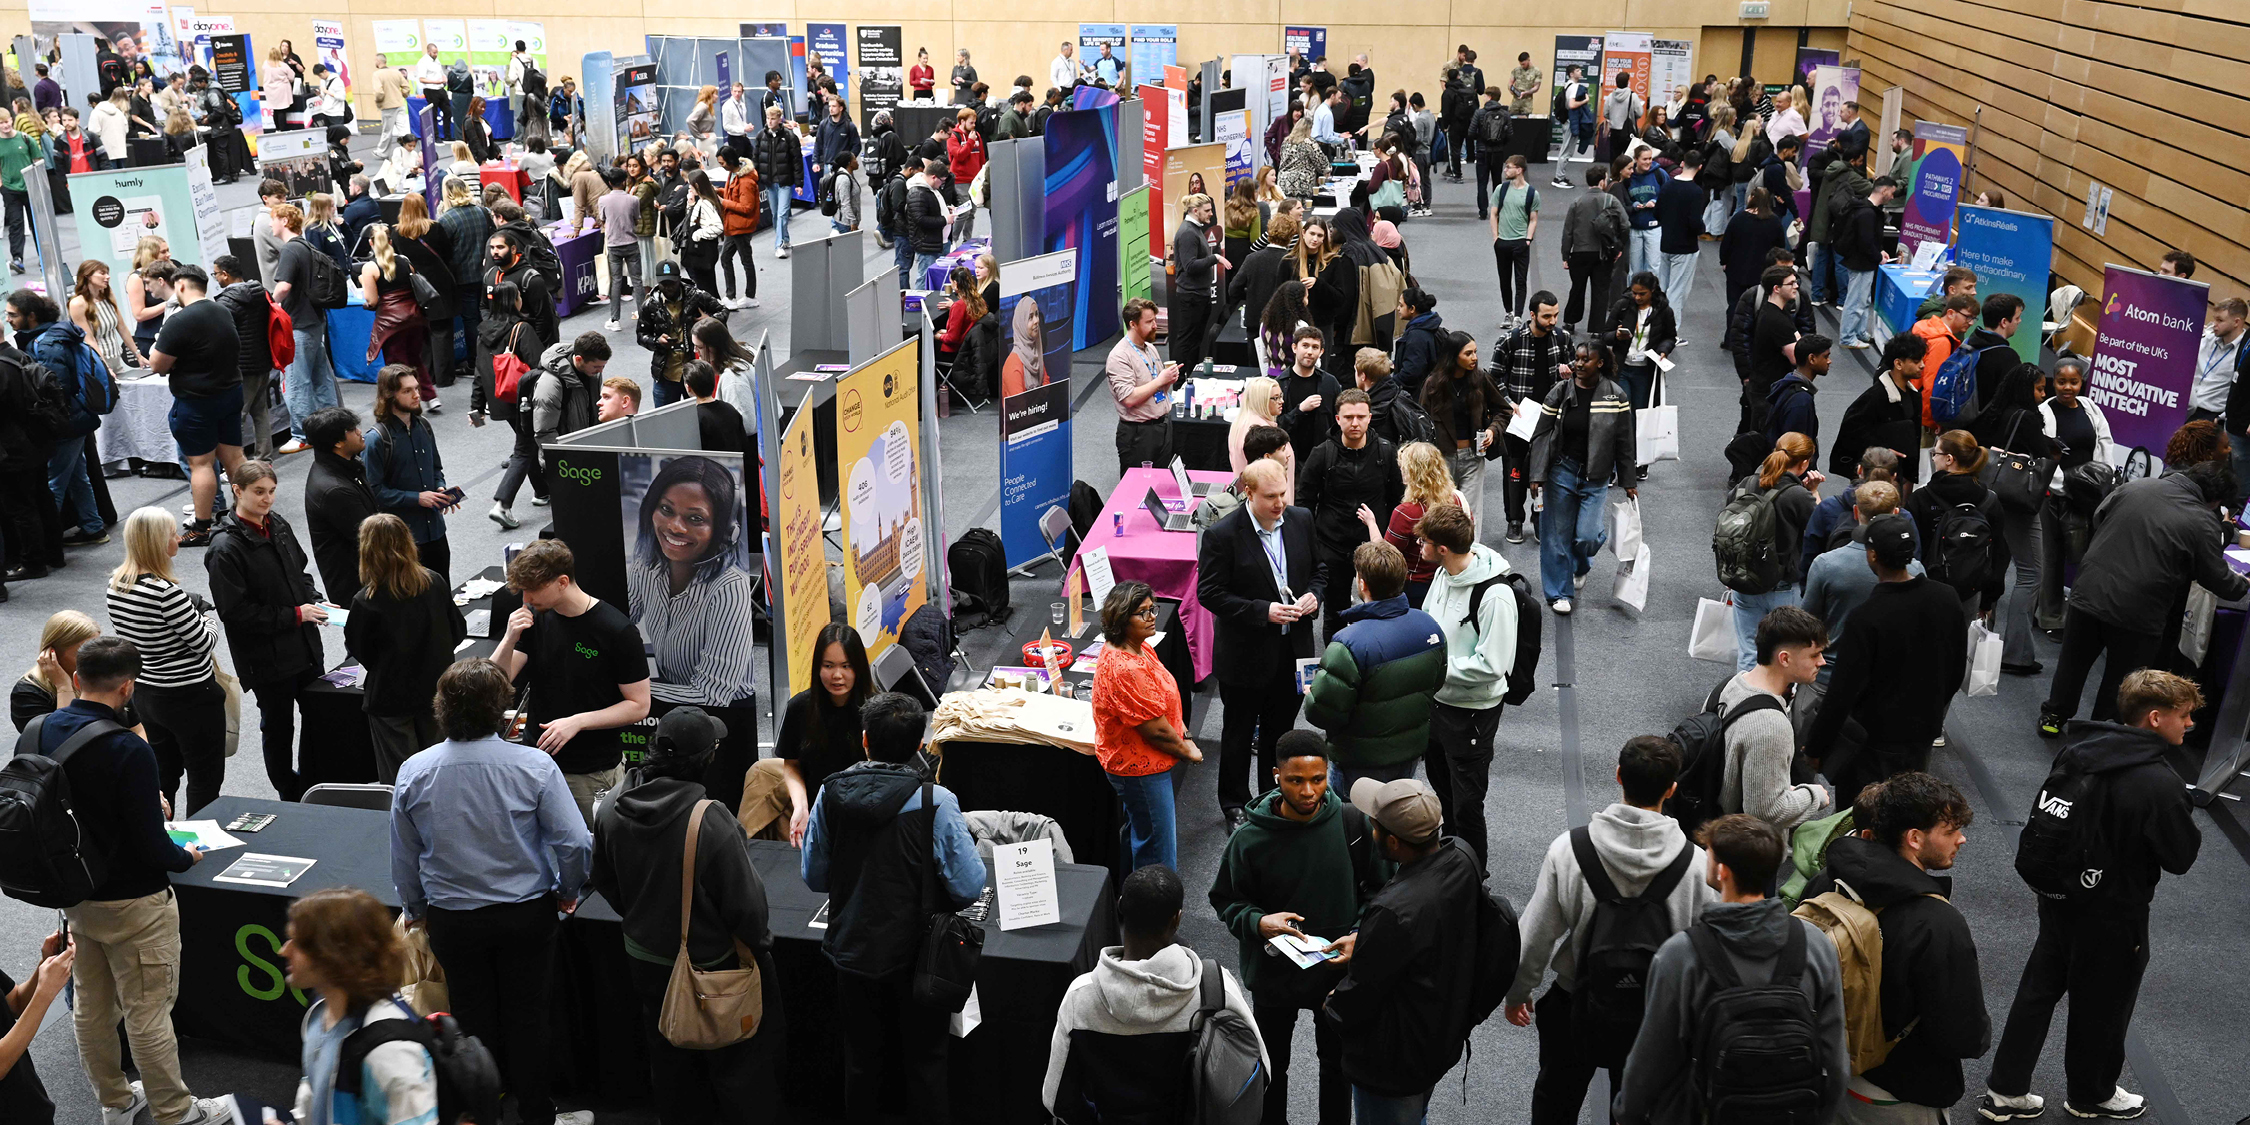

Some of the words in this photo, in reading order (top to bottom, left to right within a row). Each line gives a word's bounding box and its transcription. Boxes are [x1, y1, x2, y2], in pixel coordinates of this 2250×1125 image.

[1216, 125, 1226, 134] NHS
[1217, 131, 1246, 142] ENGINEERING
[1237, 167, 1251, 177] Training
[1925, 173, 1948, 184] PATHWAYS
[115, 178, 143, 188] humly
[1923, 190, 1950, 201] PROCUREMENT
[1097, 221, 1107, 230] Learn
[1905, 222, 1913, 230] NHS
[1913, 224, 1941, 236] PROCUREMENT
[1974, 217, 2018, 232] AtkinsRéalis
[1903, 230, 1923, 239] GRADUATE
[1924, 233, 1940, 243] TRAINING
[1061, 260, 1071, 268] NHS
[1961, 248, 1980, 259] Here
[1982, 253, 1990, 262] to
[1992, 255, 2013, 266] make
[1960, 260, 1972, 271] the
[1974, 264, 2026, 283] extraordinary
[577, 274, 597, 295] KPM
[1977, 274, 1990, 285] lity
[2125, 304, 2160, 324] Atom
[2162, 312, 2193, 332] bank
[2100, 332, 2109, 343] Be
[2109, 335, 2125, 349] part
[2126, 340, 2135, 352] of
[2136, 344, 2149, 354] the
[2151, 346, 2168, 359] UK's
[2095, 353, 2137, 378] MOST
[2091, 369, 2179, 409] INNOVATIVE
[844, 401, 860, 416] CHANGE
[885, 398, 899, 410] National
[2089, 386, 2148, 417] FINTECH
[1009, 409, 1026, 421] We're
[1028, 401, 1048, 416] hiring!
[890, 427, 901, 439] 94%
[1023, 431, 1033, 440] website
[1048, 424, 1056, 432] more
[558, 460, 602, 486] Sage
[1004, 473, 1024, 487] People
[858, 480, 868, 491] 406
[1004, 478, 1037, 496] Connected
[1011, 493, 1025, 505] Care
[786, 521, 796, 538] THE
[906, 525, 916, 536] High
[800, 519, 819, 556] SPENDING
[905, 533, 919, 548] ICAEW
[575, 642, 598, 659] Sage
[620, 732, 646, 744] the
[2038, 790, 2073, 819] VANS
[1018, 847, 1028, 855] 19
[1016, 861, 1032, 869] Sage
